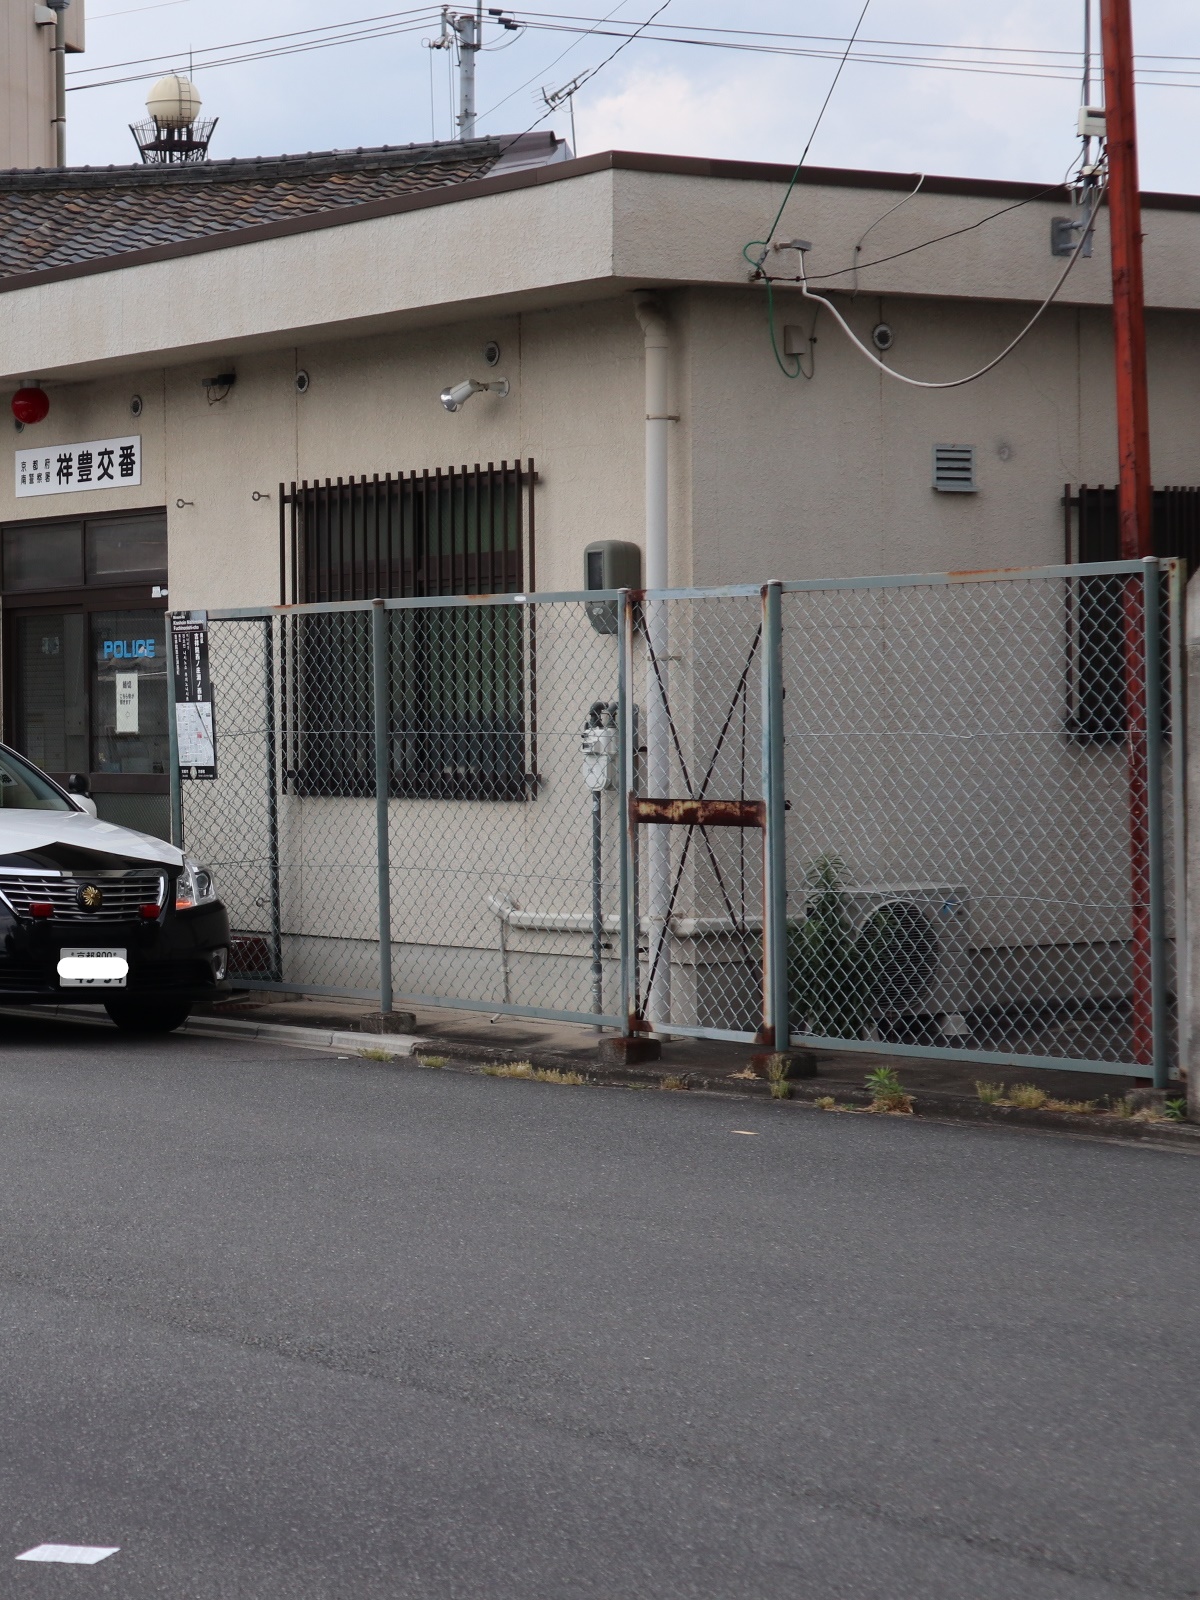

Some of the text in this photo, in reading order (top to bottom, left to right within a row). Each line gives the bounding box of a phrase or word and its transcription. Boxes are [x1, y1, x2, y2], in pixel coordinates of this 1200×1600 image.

[20, 458, 51, 472] 京都府
[56, 444, 136, 486] 祥豊交番
[20, 471, 51, 485] 南警察署
[103, 638, 156, 659] POLICE
